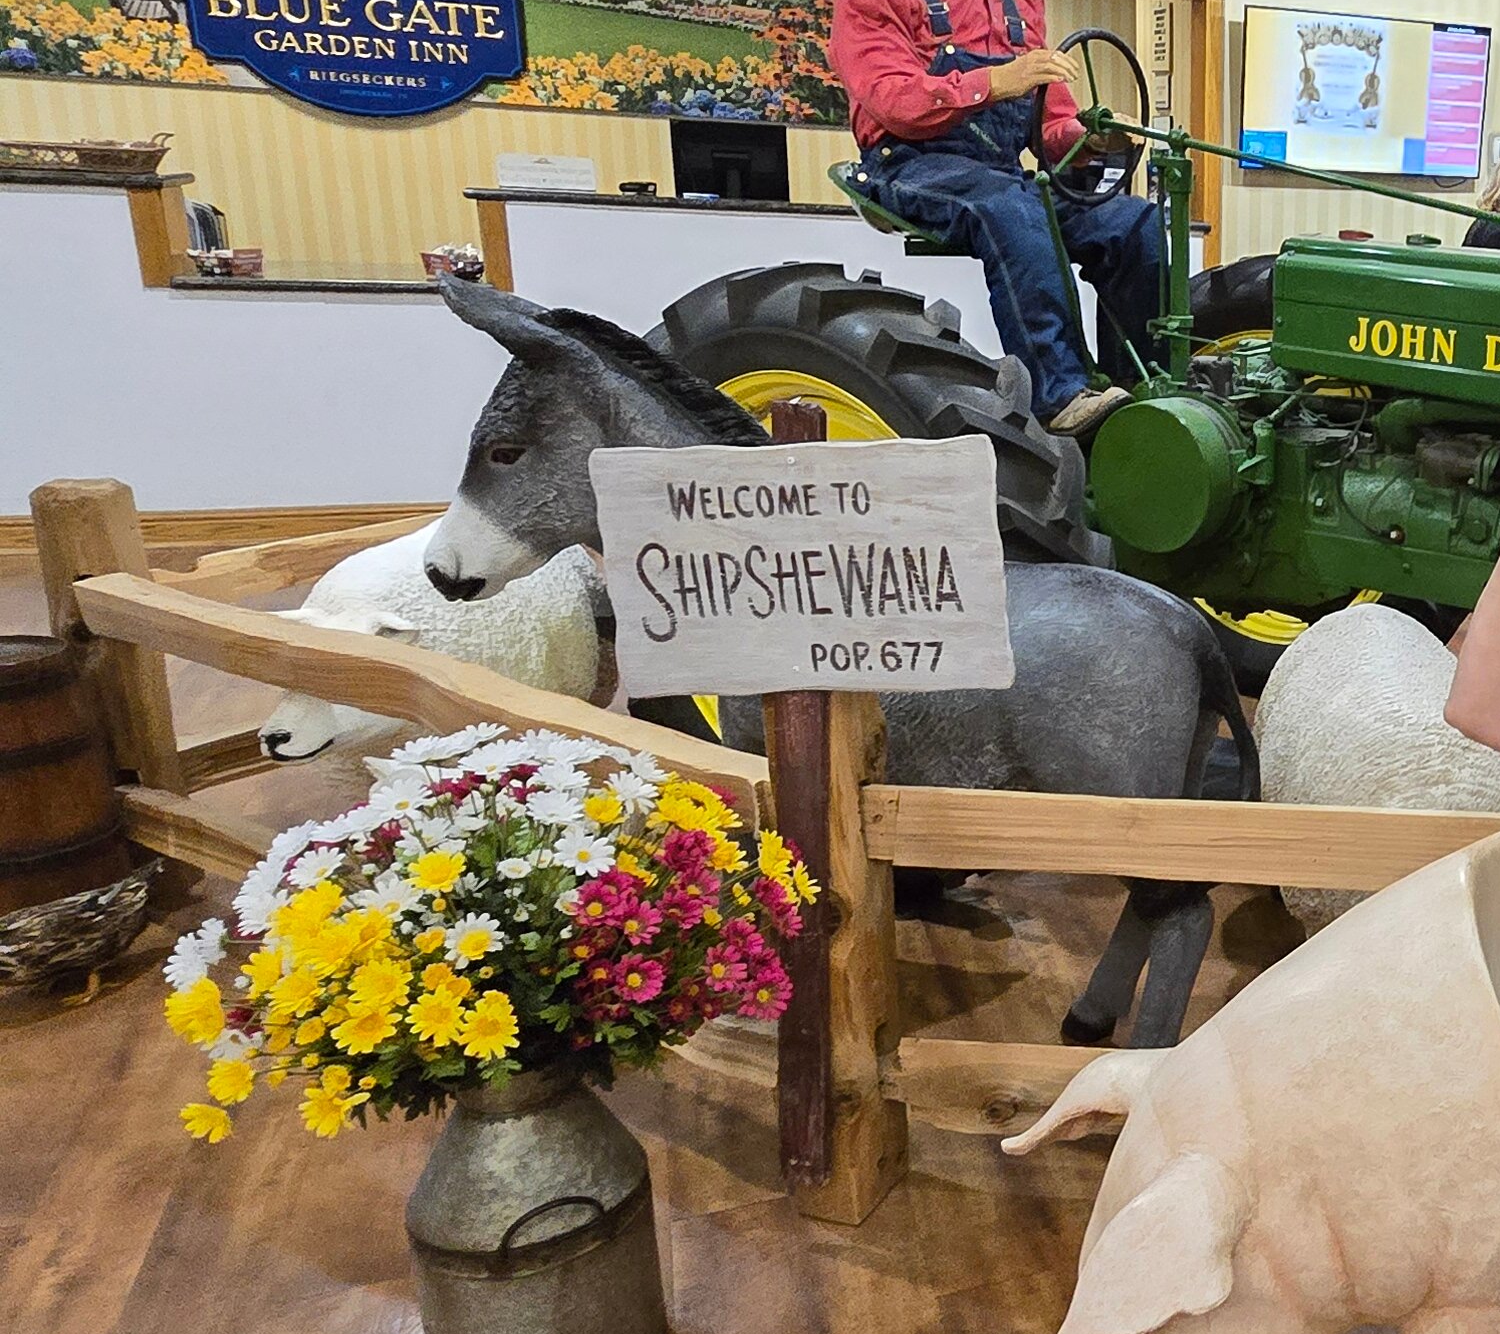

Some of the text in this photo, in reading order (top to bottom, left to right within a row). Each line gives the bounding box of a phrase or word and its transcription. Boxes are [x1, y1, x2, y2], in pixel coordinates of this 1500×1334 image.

[253, 29, 469, 65] GARDEN INN
[1349, 317, 1457, 364] JOHN
[666, 480, 871, 522] WELCOME TO
[636, 542, 964, 643] SHIPSHEWANA
[811, 640, 943, 672] POP. 677
